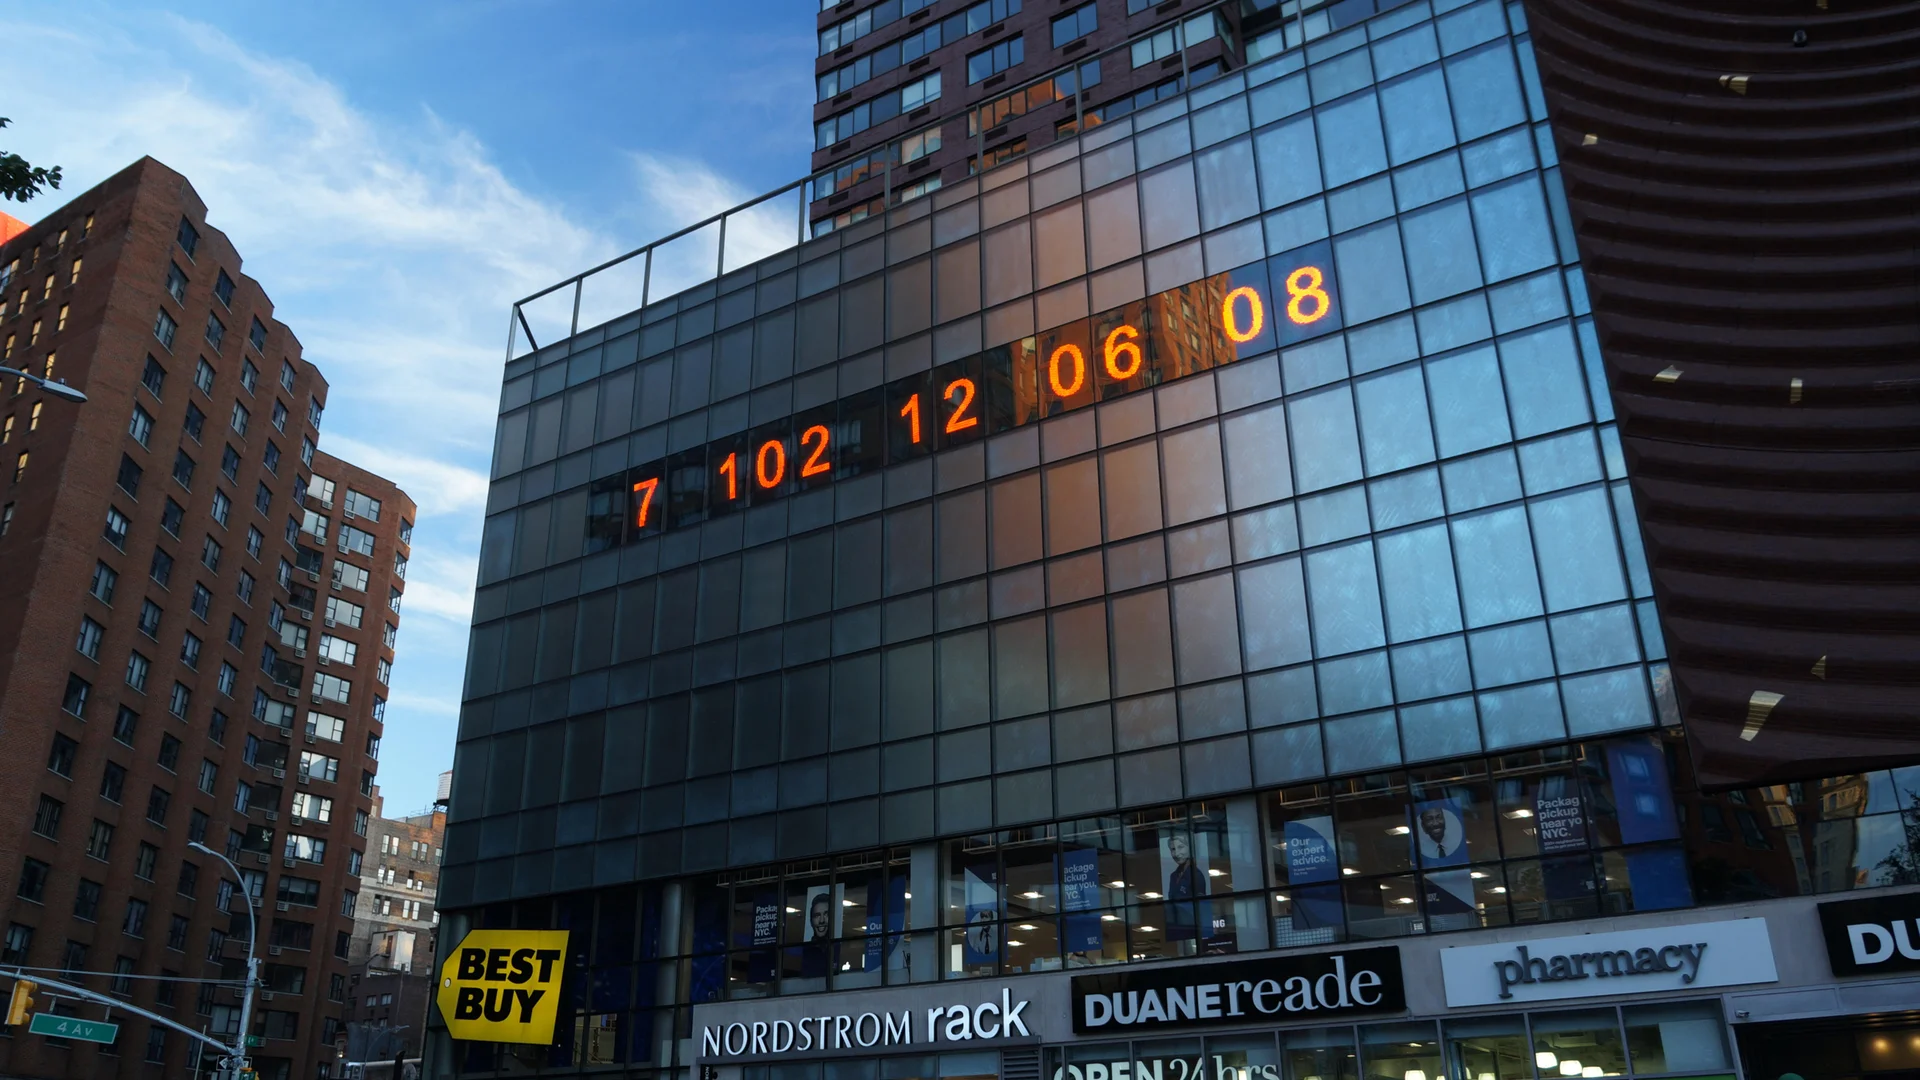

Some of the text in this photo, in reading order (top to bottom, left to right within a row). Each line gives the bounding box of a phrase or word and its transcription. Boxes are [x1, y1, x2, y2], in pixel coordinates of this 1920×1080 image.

[633, 267, 1331, 528] 7 102 12 06 08
[1539, 807, 1579, 821] pickup
[1540, 818, 1566, 829] near
[1541, 827, 1571, 839] NYC.
[1290, 837, 1310, 847] Our
[1292, 843, 1325, 857] expert
[1292, 854, 1329, 866] advice.
[1064, 864, 1094, 873] ackage
[1064, 873, 1087, 883] ickup
[1064, 882, 1078, 891] ear
[1065, 890, 1081, 900] YC.
[457, 947, 562, 985] BEST
[1493, 942, 1708, 999] pharmacy
[454, 987, 547, 1024] BUY
[56, 1021, 94, 1036] 4 Av
[702, 987, 1032, 1057] NORDSTROM rack
